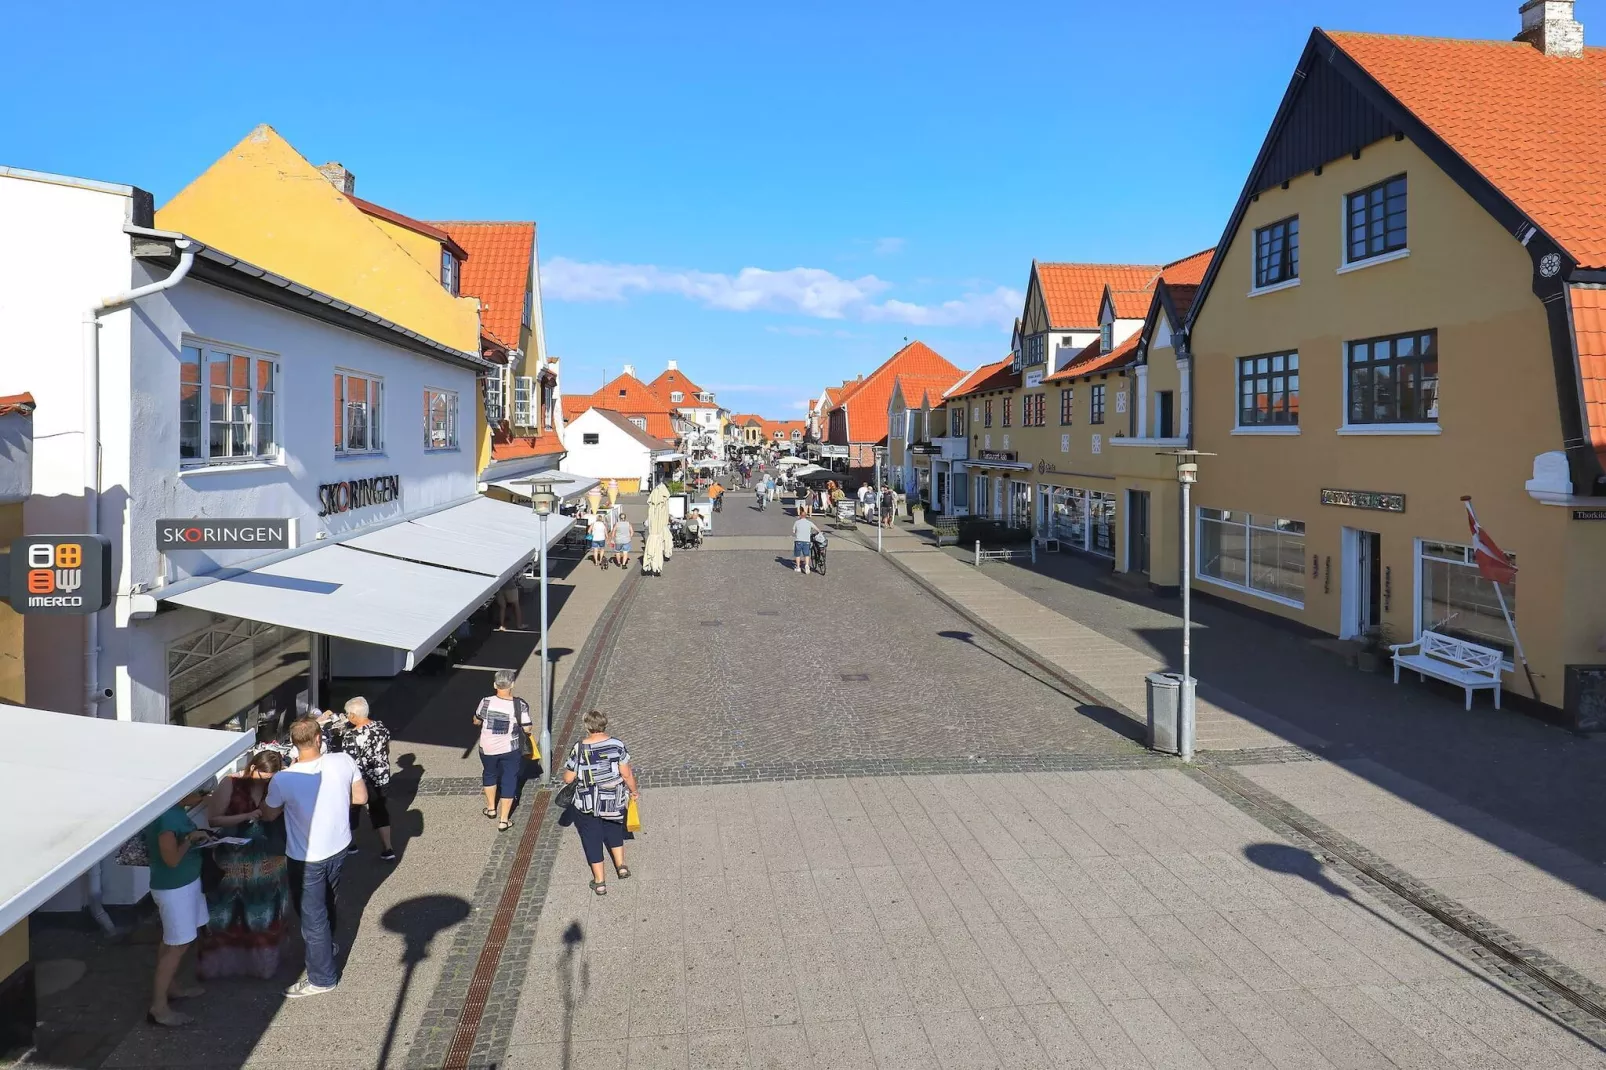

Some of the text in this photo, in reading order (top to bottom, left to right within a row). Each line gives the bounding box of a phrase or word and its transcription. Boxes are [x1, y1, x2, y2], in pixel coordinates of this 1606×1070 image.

[318, 475, 399, 517] SKORINGEN
[163, 528, 282, 542] SKORINGEN
[28, 596, 82, 607] IMERCO
